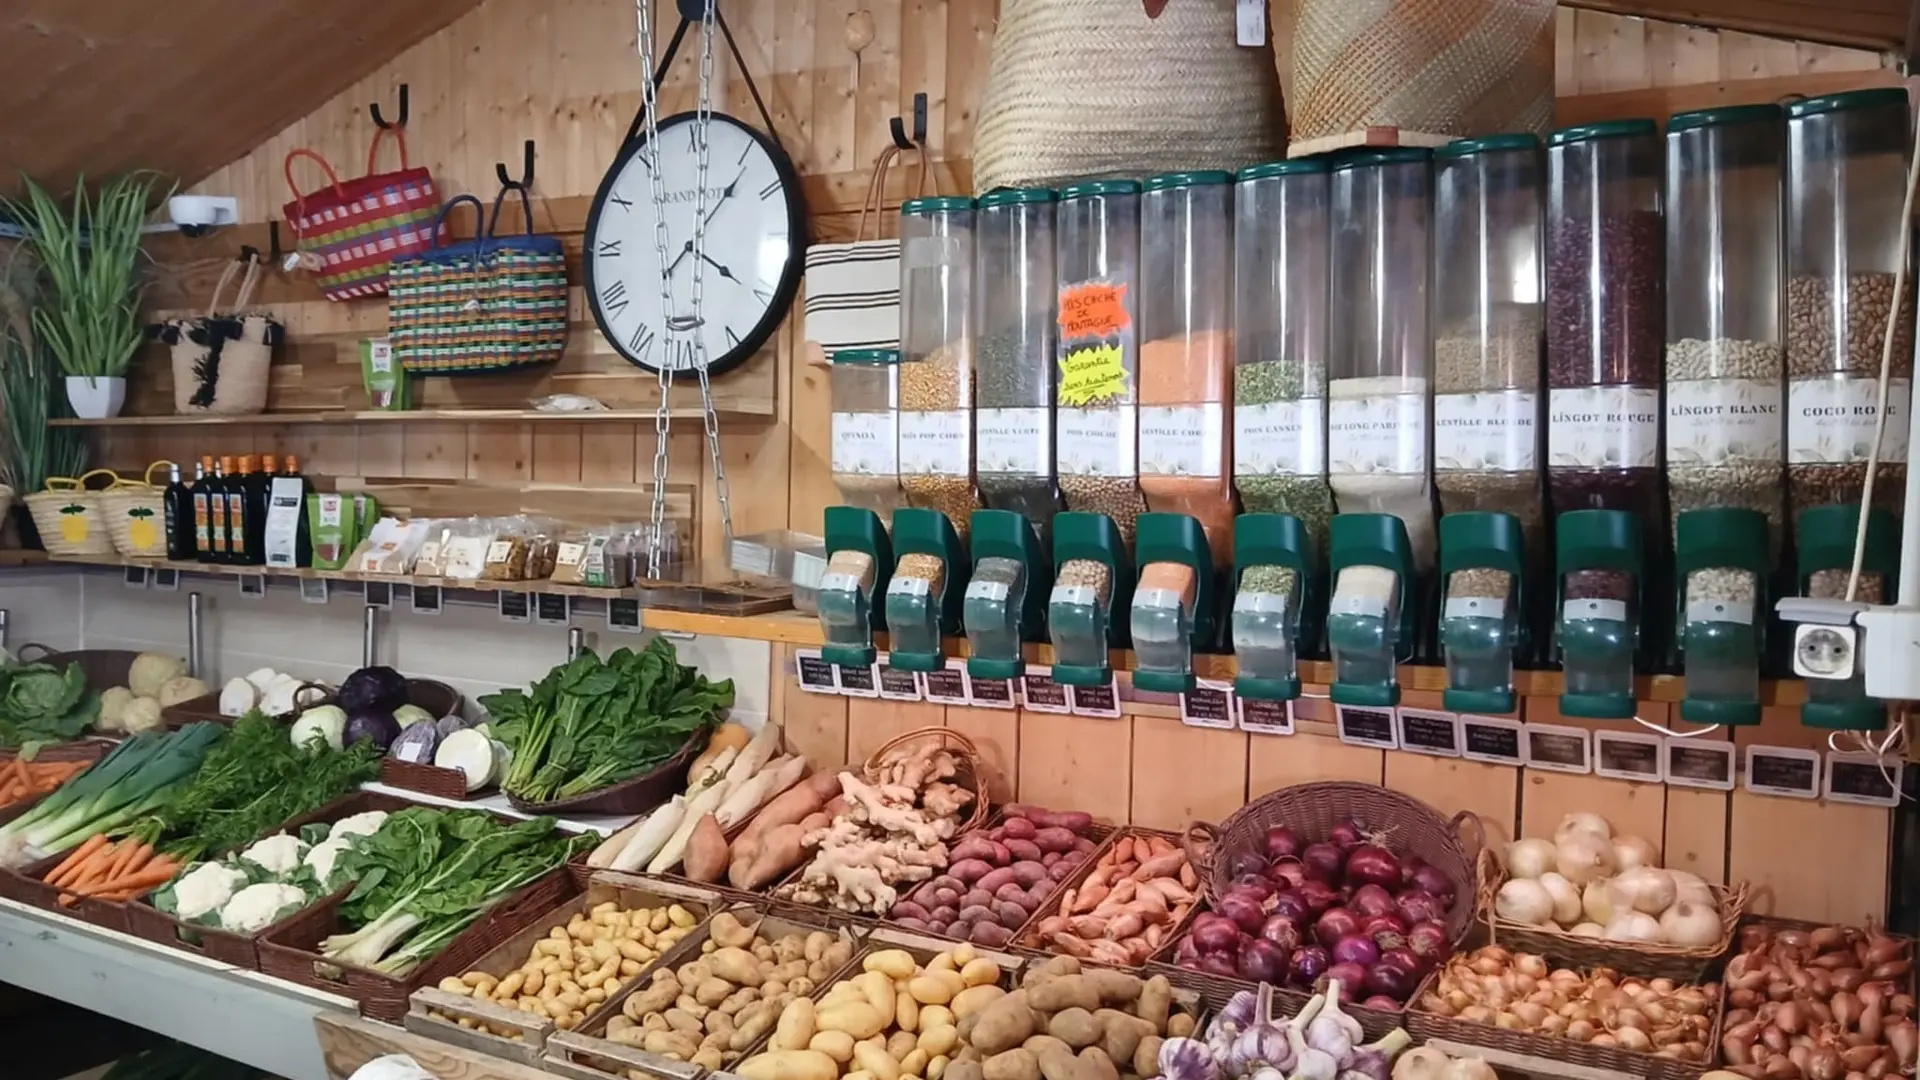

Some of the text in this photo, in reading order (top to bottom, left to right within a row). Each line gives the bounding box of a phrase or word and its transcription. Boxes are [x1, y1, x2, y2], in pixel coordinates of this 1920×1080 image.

[1729, 404, 1777, 415] BLANC
[1802, 405, 1897, 417] COCO ROE
[1436, 417, 1482, 427] LENTILLE
[1606, 412, 1656, 423] ROUGE
[1344, 422, 1371, 431] LONG
